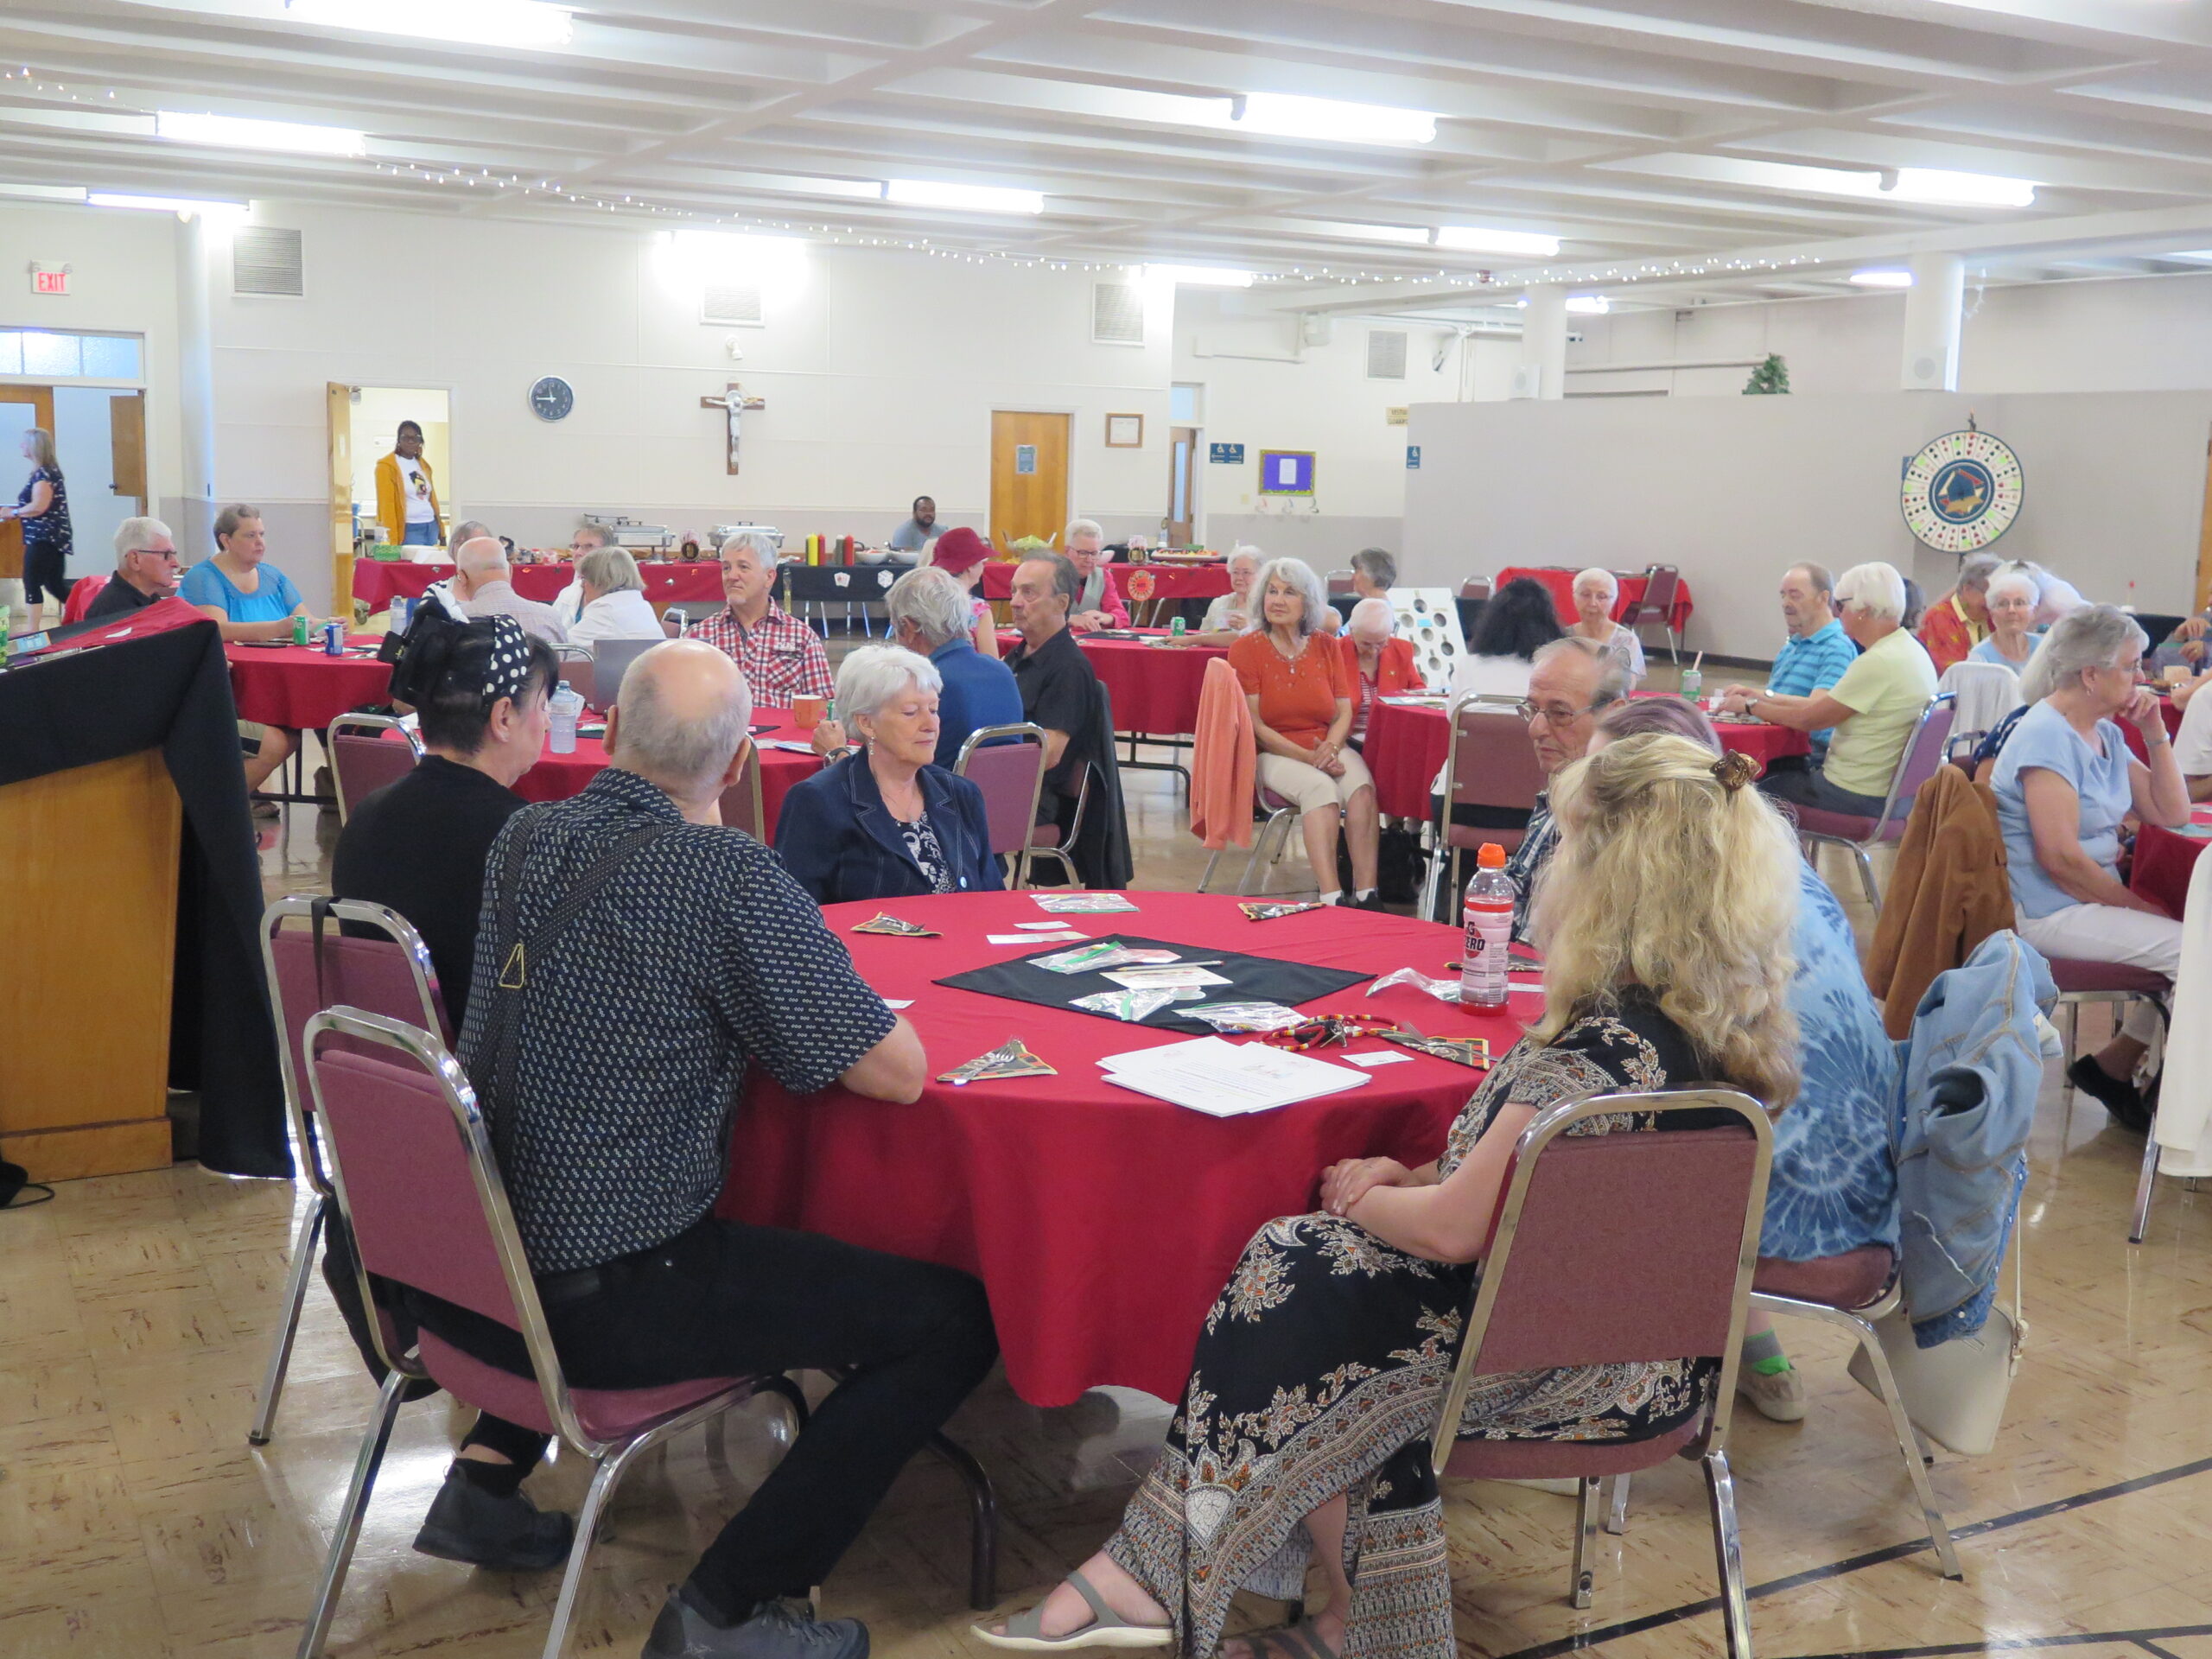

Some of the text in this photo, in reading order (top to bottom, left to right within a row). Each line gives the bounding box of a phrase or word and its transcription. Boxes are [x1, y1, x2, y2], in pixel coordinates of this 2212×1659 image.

[38, 272, 65, 291] EXIT
[1467, 921, 1475, 936] G
[1465, 937, 1486, 951] ERO
